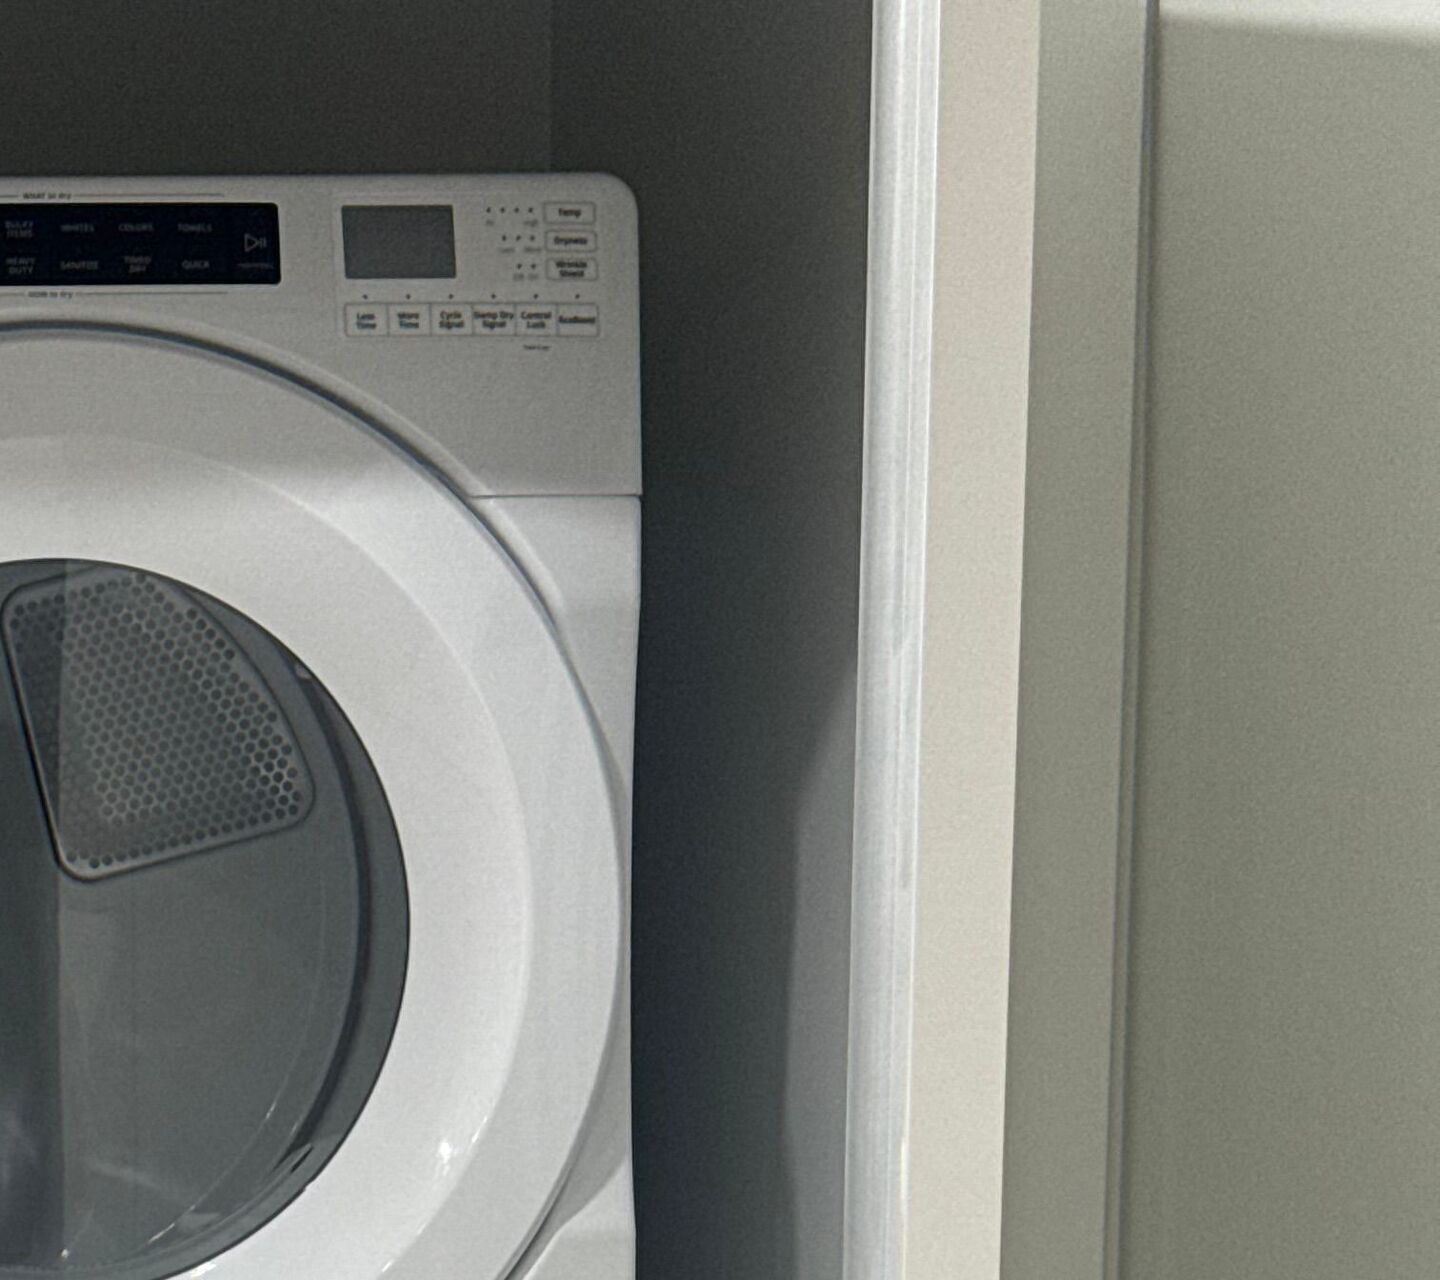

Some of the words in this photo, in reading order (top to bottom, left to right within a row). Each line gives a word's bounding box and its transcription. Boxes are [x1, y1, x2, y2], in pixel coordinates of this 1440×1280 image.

[559, 208, 582, 218] Temp
[118, 223, 154, 232] COLORS
[177, 223, 212, 233] TOWELS
[181, 260, 210, 270] QUICK
[8, 266, 33, 274] DUTY
[440, 311, 461, 320] Cycle
[499, 311, 514, 320] Dry
[521, 311, 551, 319] Control
